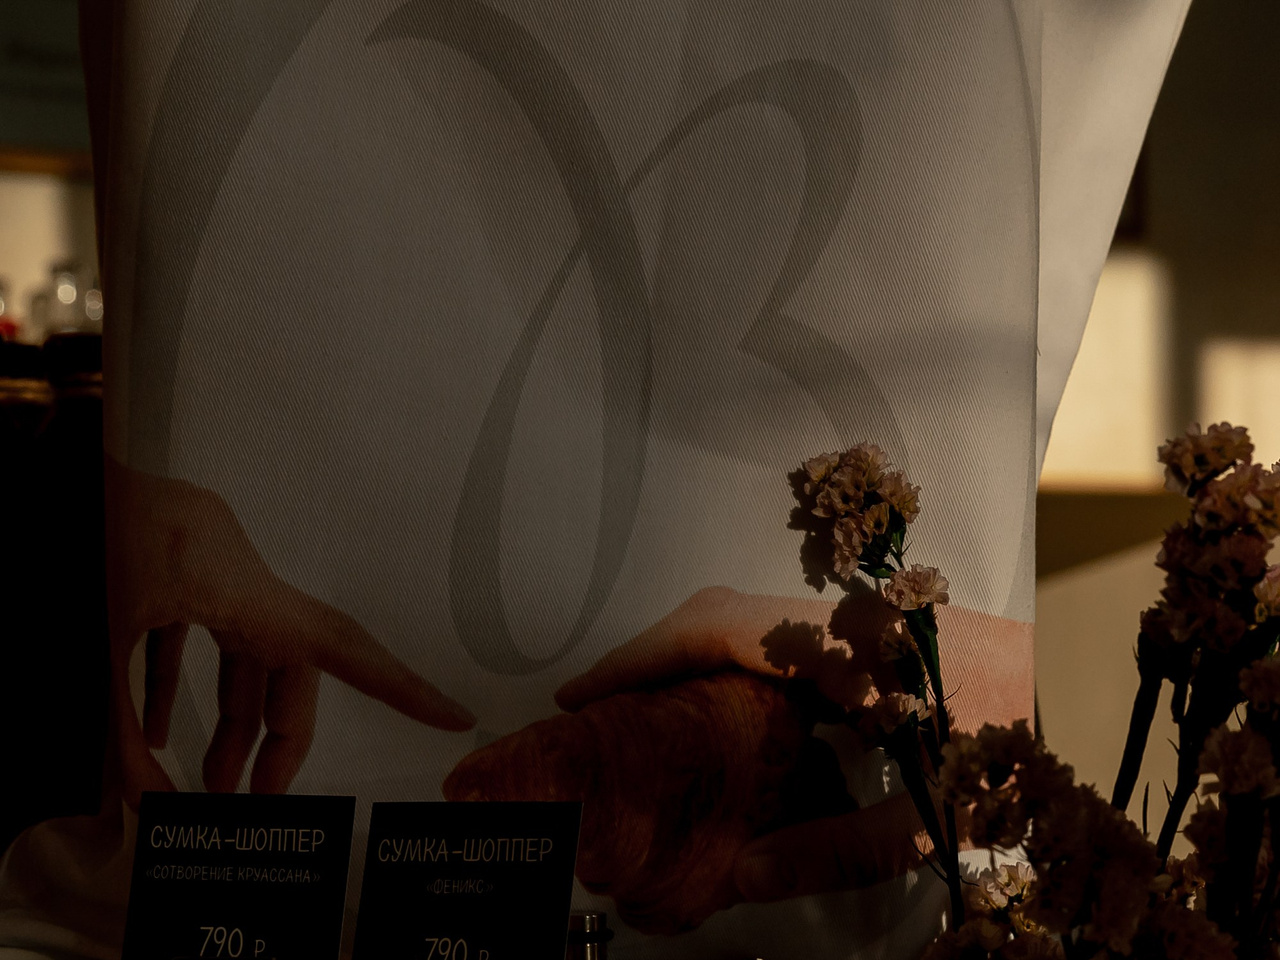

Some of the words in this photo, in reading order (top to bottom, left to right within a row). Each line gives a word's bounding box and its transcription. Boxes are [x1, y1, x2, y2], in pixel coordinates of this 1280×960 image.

[150, 825, 326, 853] СУМКА-ШОППЕР
[377, 837, 554, 862] СУМКА-ШОППЕР
[200, 926, 244, 958] 790
